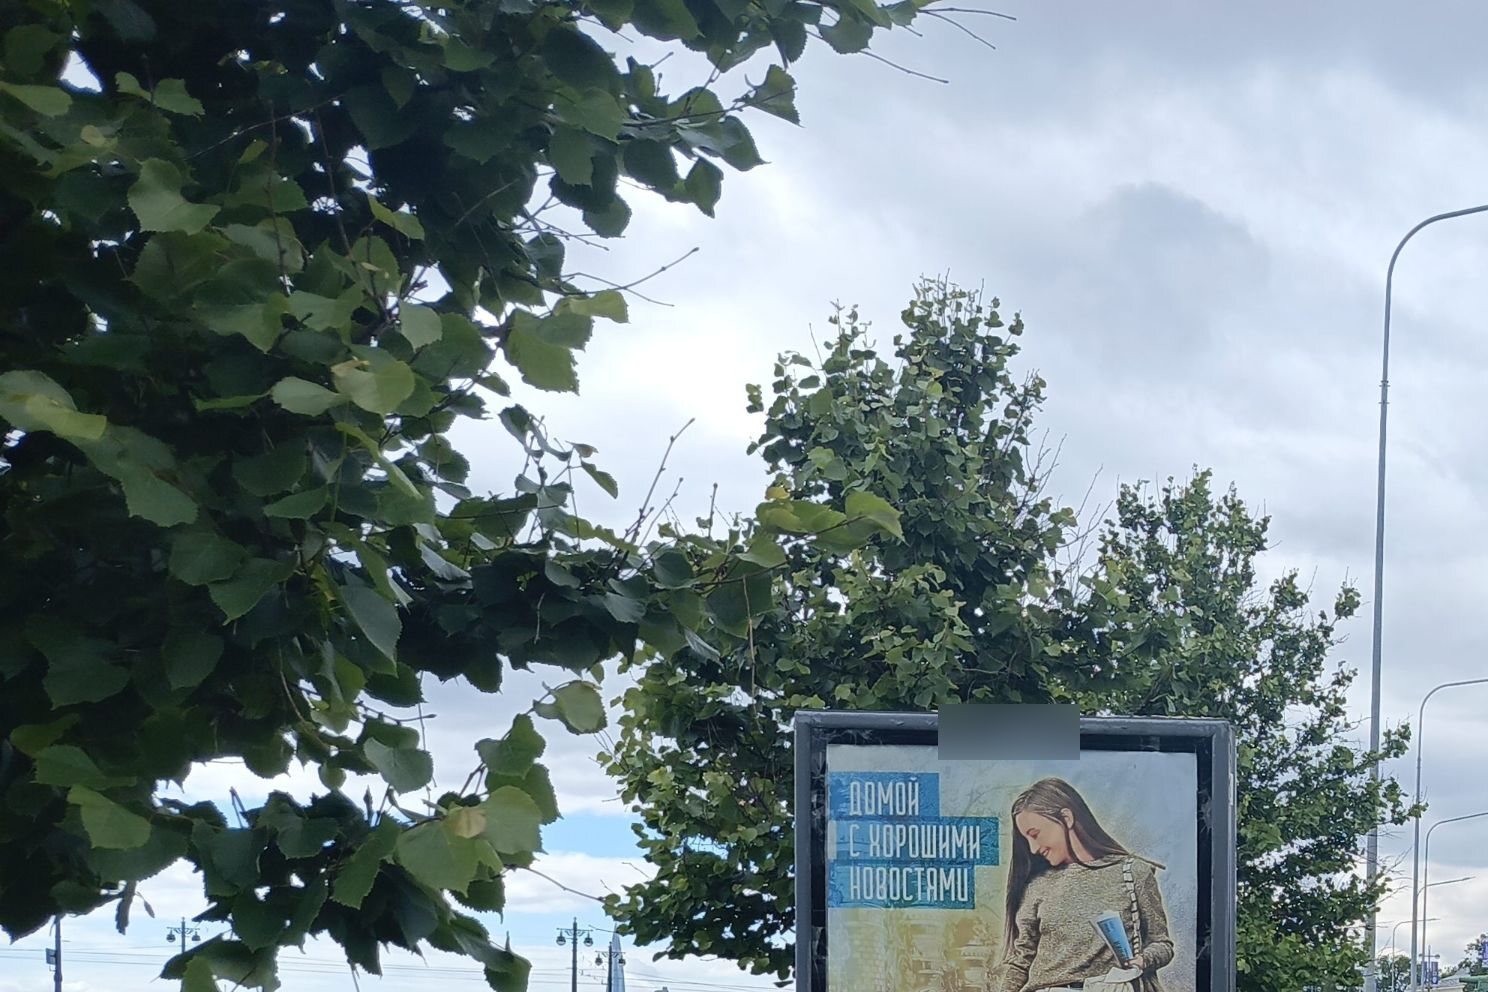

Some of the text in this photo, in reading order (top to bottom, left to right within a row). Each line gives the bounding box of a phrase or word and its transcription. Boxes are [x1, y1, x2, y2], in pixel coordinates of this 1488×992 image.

[849, 777, 919, 816] ДОМОЙ
[850, 824, 980, 859] С ХОРОШИМИ
[850, 866, 968, 902] НОВОСТЯМИ
